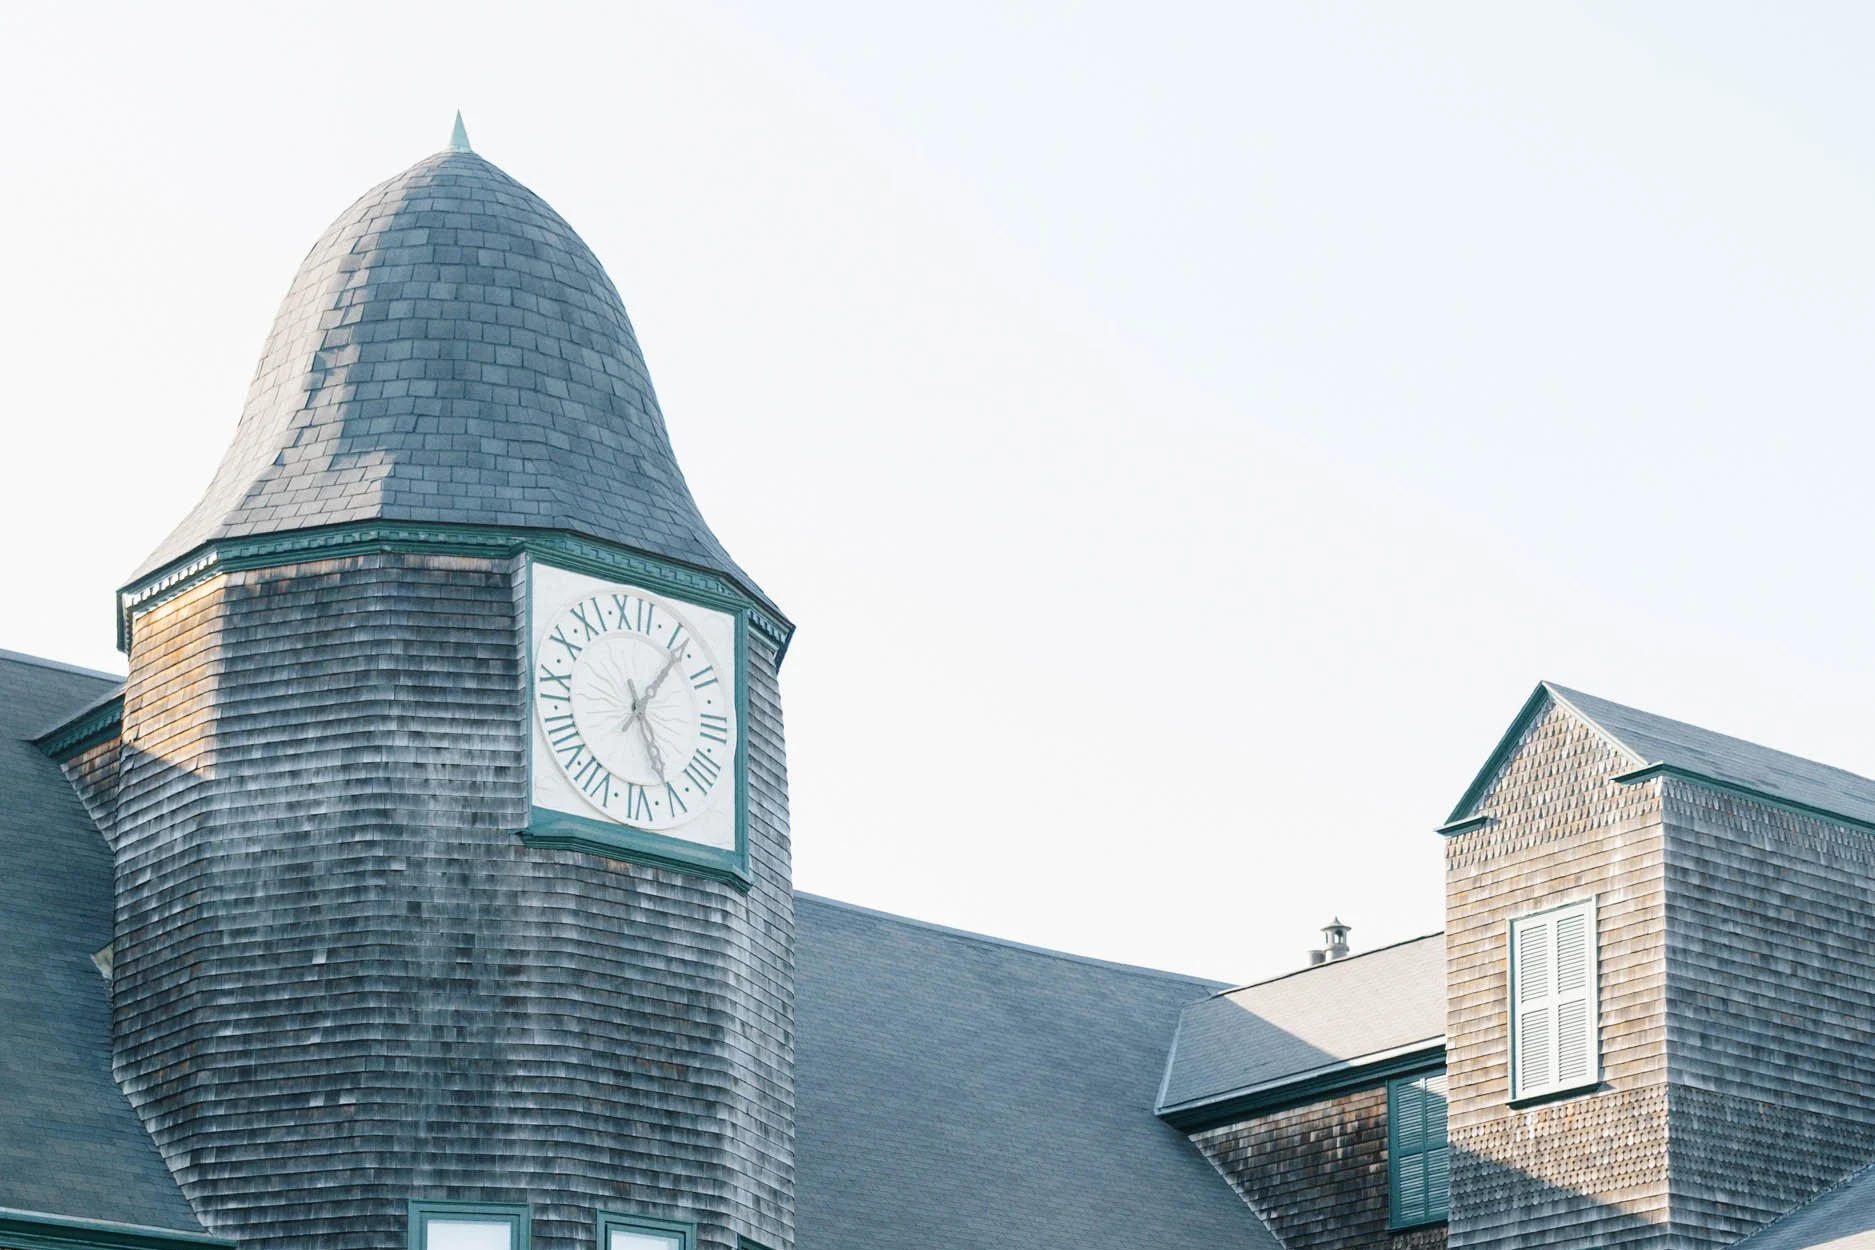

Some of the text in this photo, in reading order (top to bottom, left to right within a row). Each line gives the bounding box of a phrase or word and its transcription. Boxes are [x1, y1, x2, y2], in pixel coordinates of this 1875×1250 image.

[570, 597, 607, 641] XI
[612, 594, 655, 635] XII
[550, 624, 582, 660] X
[667, 623, 683, 649] I
[540, 664, 572, 701] IX
[690, 666, 718, 689] II
[700, 713, 727, 744] III
[574, 756, 611, 807] VII
[683, 748, 721, 795] IIII
[627, 783, 653, 821] VI
[666, 781, 687, 818] V
